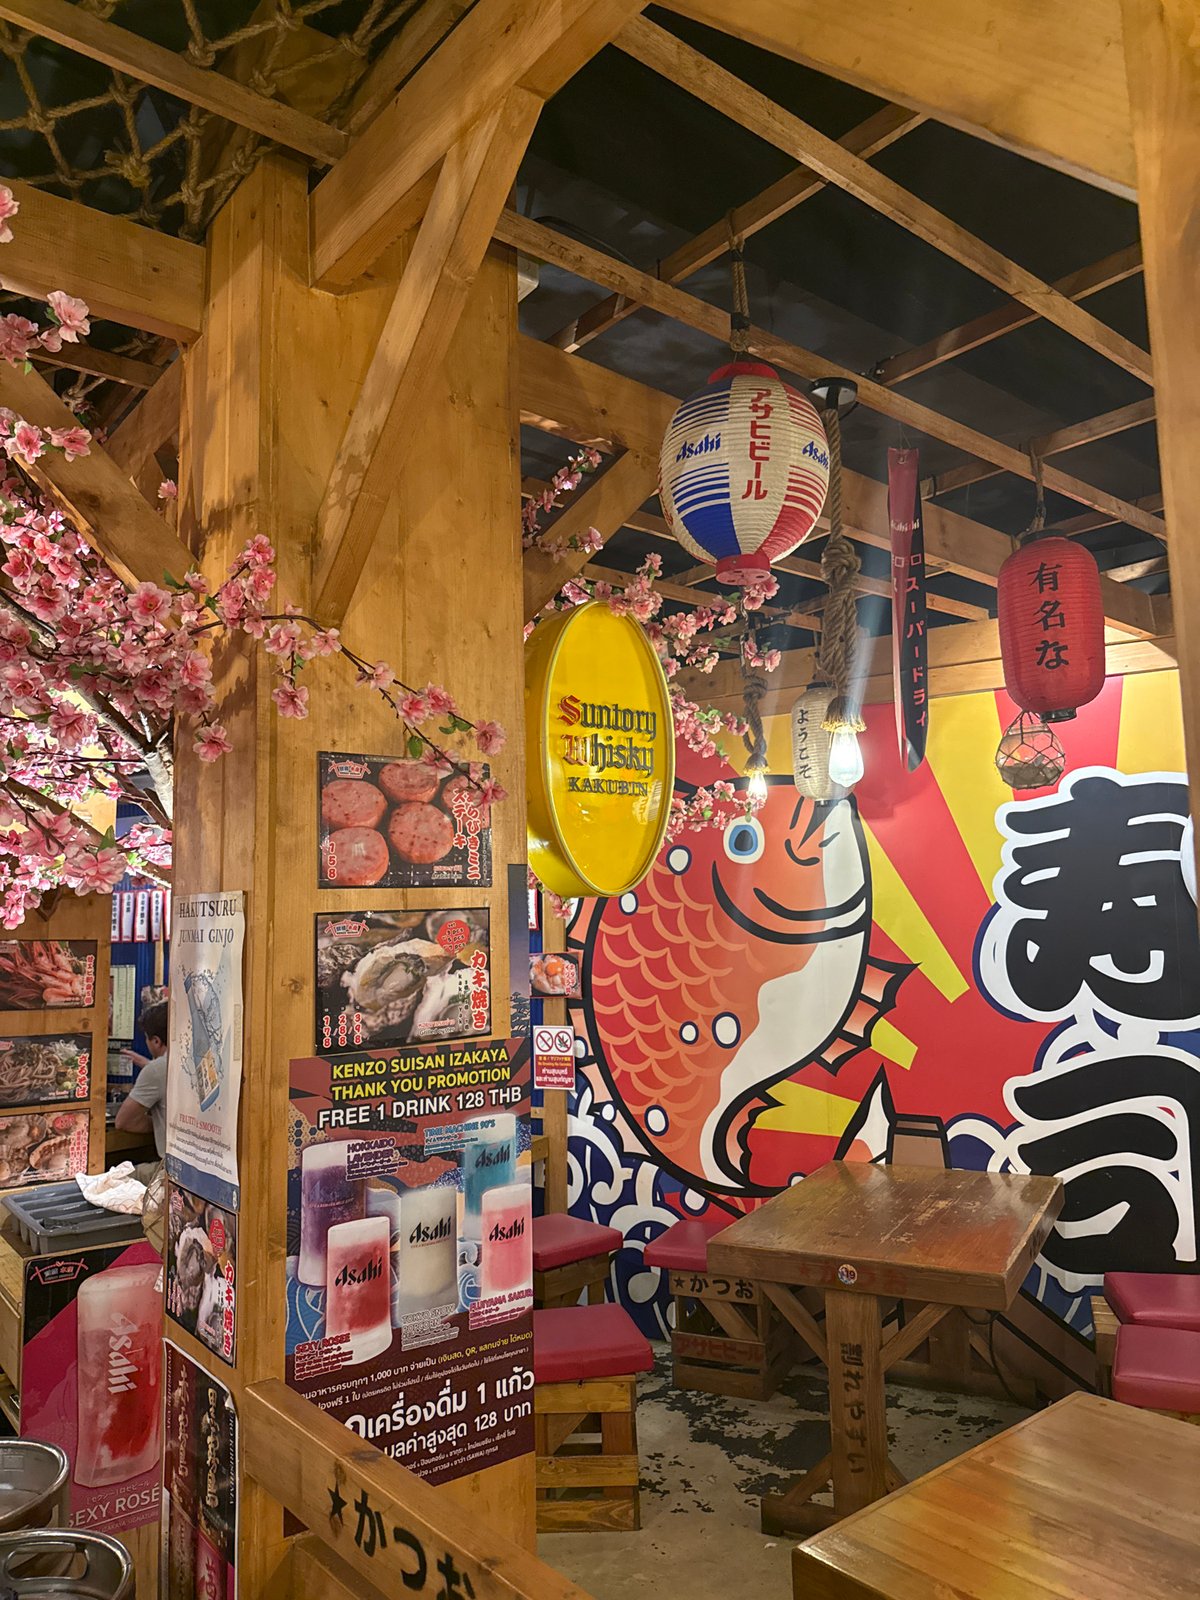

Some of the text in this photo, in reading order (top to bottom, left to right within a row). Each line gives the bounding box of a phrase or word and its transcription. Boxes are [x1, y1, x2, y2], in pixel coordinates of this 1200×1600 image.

[676, 433, 721, 463] Asahi
[742, 388, 774, 500] アサヒビール
[1027, 562, 1069, 670] 有名な
[557, 695, 657, 742] Suntory
[561, 733, 655, 778] Whisky
[797, 709, 812, 779] ようこそ
[568, 776, 648, 797] KAKUBIN
[466, 793, 481, 880] らびきミニ
[179, 899, 237, 918] HAKUTSURU
[208, 928, 234, 948] GINJO
[471, 950, 489, 1029] カキ焼き
[76, 1053, 89, 1098] ざるそば
[333, 1049, 508, 1079] KENZO SUISAN IZAKAYA
[332, 1067, 511, 1100] THANK YOU PROMOTION
[319, 1086, 522, 1128] FREE 1 DRINK 128 THB
[445, 1122, 479, 1133] MACHINE
[347, 1138, 394, 1153] HOKKAIDO
[475, 1144, 511, 1168] Asahi
[409, 1216, 451, 1243] Asahi
[489, 1217, 525, 1242] Asahi
[335, 1257, 383, 1287] Asahi
[690, 1275, 754, 1300] かつお
[108, 1312, 140, 1394] Asahi
[370, 1369, 392, 1382] 1,000
[393, 1366, 408, 1376] บาท
[410, 1357, 437, 1370] จ่ายเป็น
[476, 1384, 485, 1405] 1
[495, 1367, 535, 1399] แก้ว
[474, 1412, 497, 1432] 128
[504, 1401, 531, 1423] บาท
[116, 1483, 160, 1513] ROSÉ
